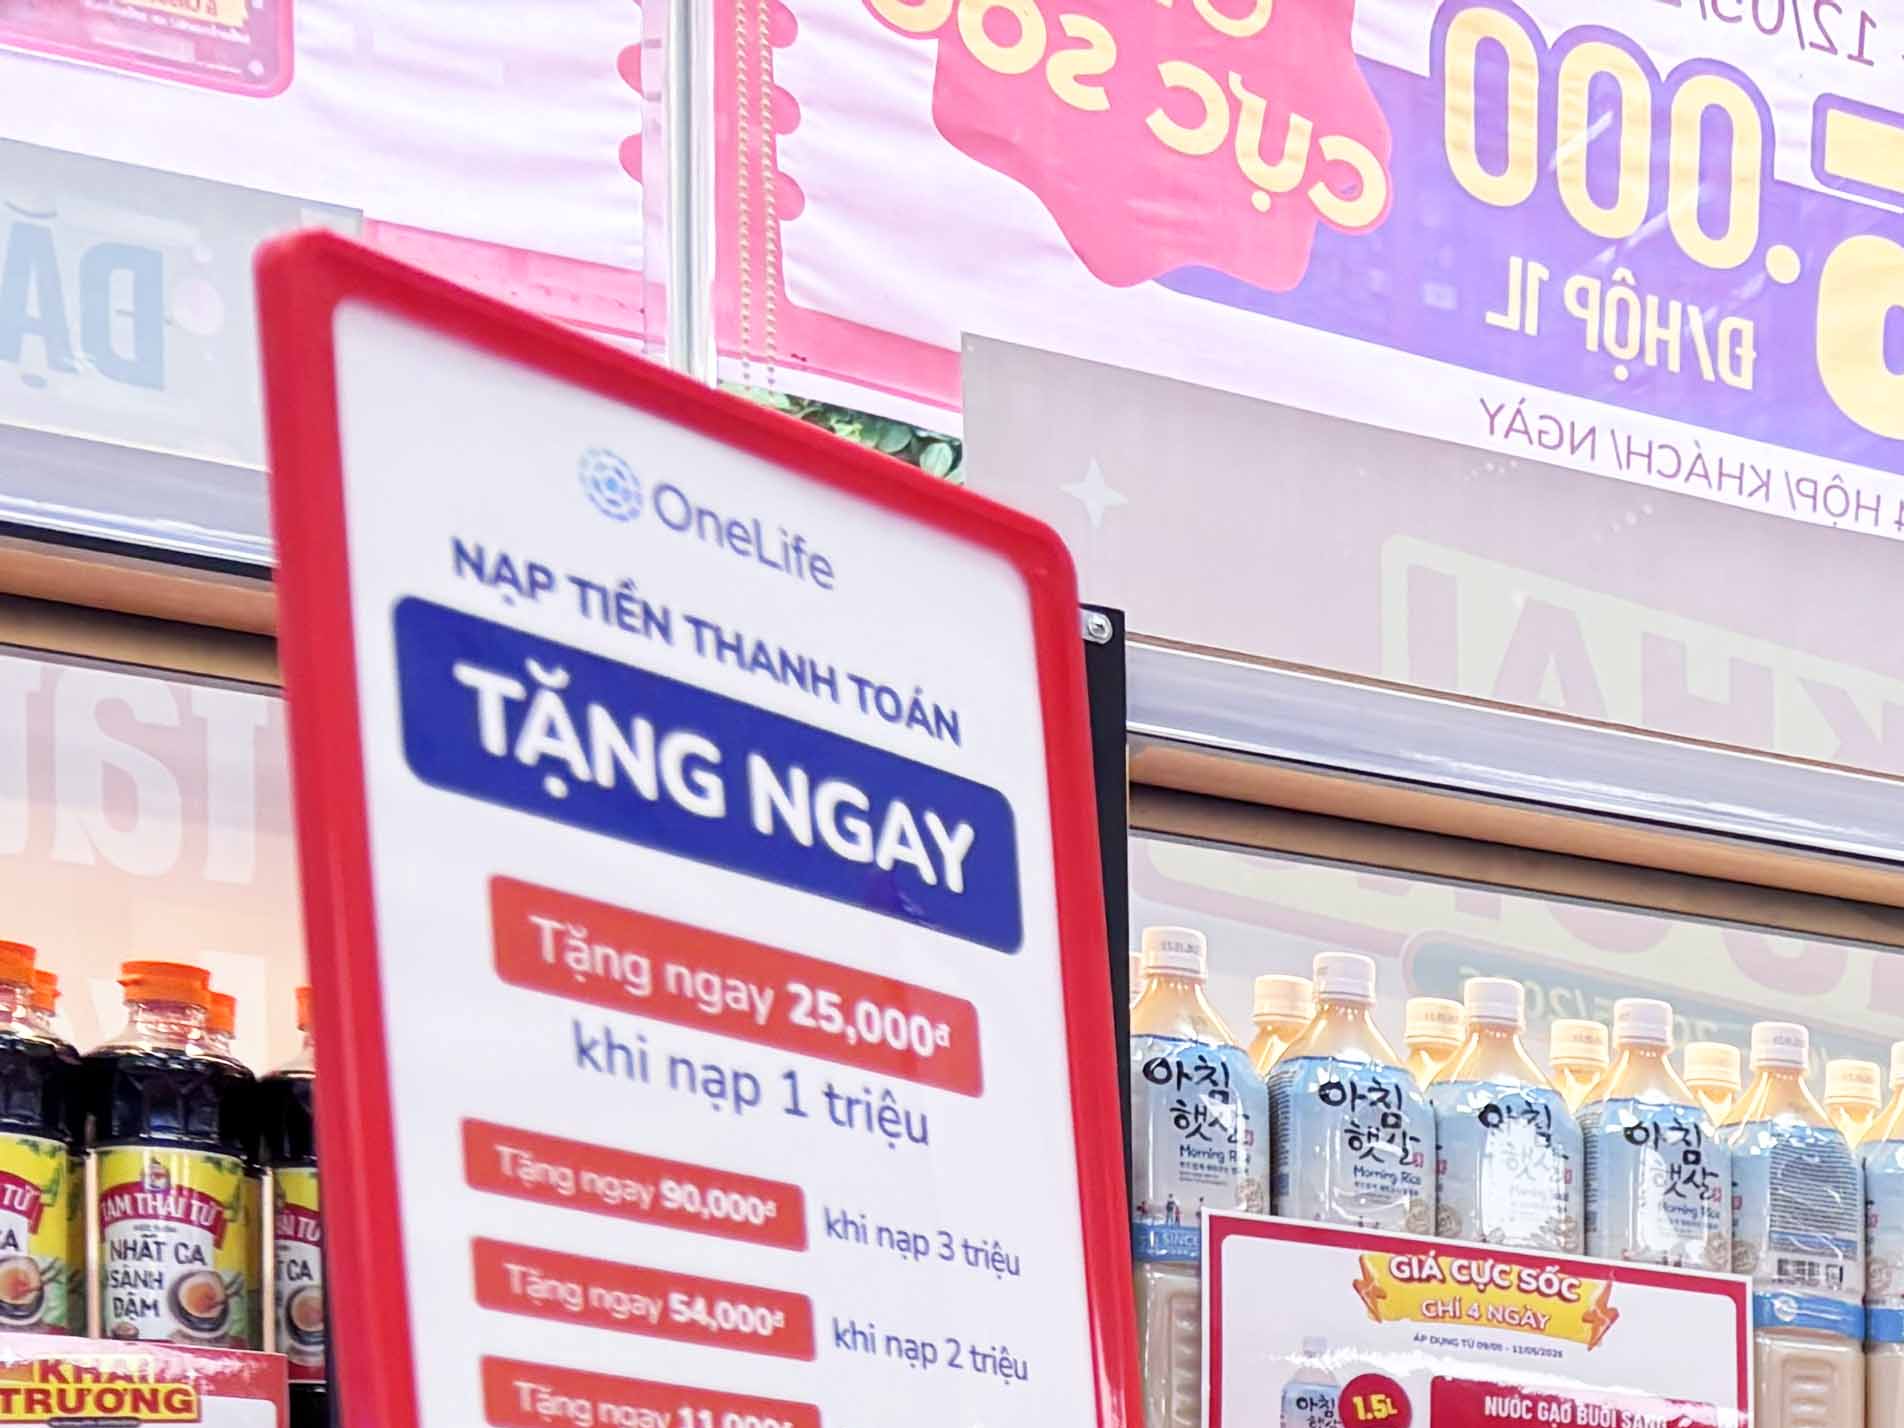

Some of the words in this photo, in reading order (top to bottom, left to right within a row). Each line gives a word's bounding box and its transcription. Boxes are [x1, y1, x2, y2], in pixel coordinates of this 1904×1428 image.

[653, 483, 836, 591] OneLife
[451, 536, 555, 604] NẠP
[569, 574, 671, 646] TIỀN
[684, 613, 840, 705] THANH
[848, 670, 962, 747] TOÁN
[453, 658, 728, 819] TẶNG
[749, 748, 976, 896] NGAY
[529, 914, 652, 996] Tặng
[664, 963, 775, 1028] ngay
[573, 1020, 649, 1084] khi
[668, 1056, 763, 1118] nạp
[782, 1070, 808, 1117] 1
[824, 1081, 929, 1152] triệu
[1390, 1251, 1444, 1281] GIÁ
[1452, 1258, 1511, 1292] CỰC
[1520, 1265, 1581, 1301] SỐC
[1467, 1302, 1480, 1319] 4
[1487, 1303, 1550, 1329] NGÀY
